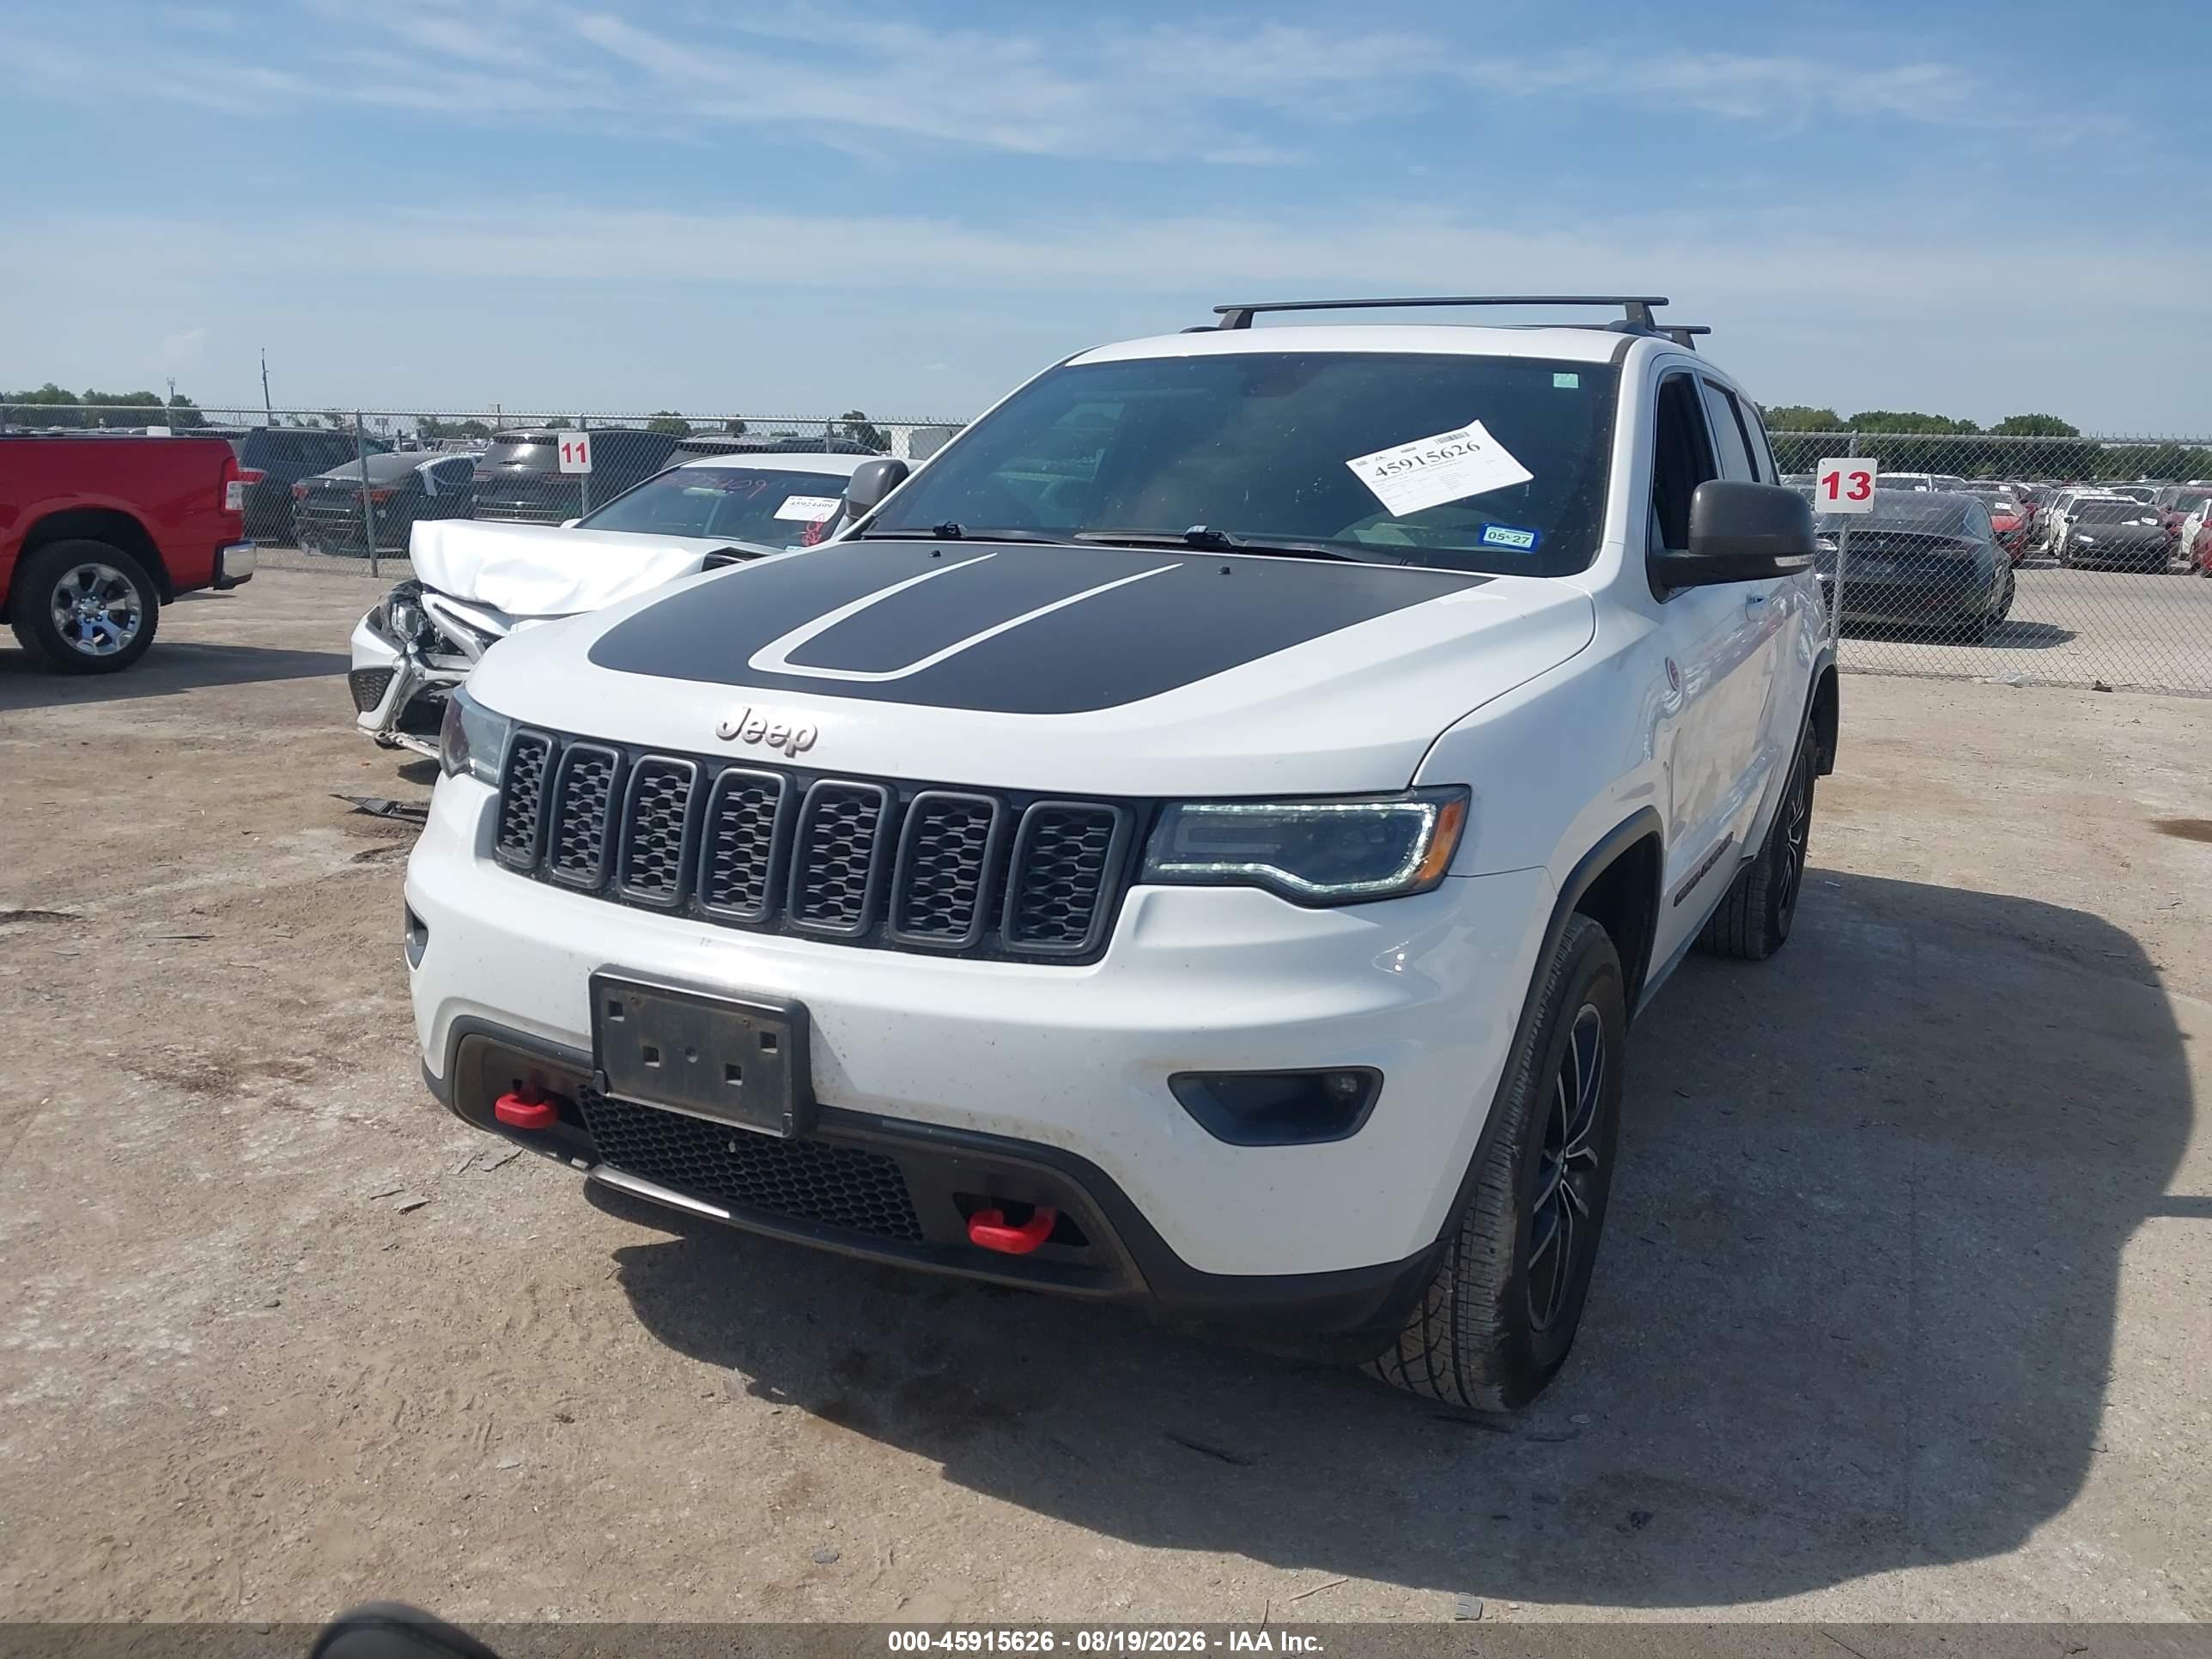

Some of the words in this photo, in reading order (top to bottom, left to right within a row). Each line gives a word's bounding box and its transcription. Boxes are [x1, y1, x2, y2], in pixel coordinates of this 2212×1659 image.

[562, 442, 586, 463] 11
[1375, 441, 1480, 477] 45915626
[1822, 471, 1871, 500] 13
[716, 707, 818, 758] Jeep
